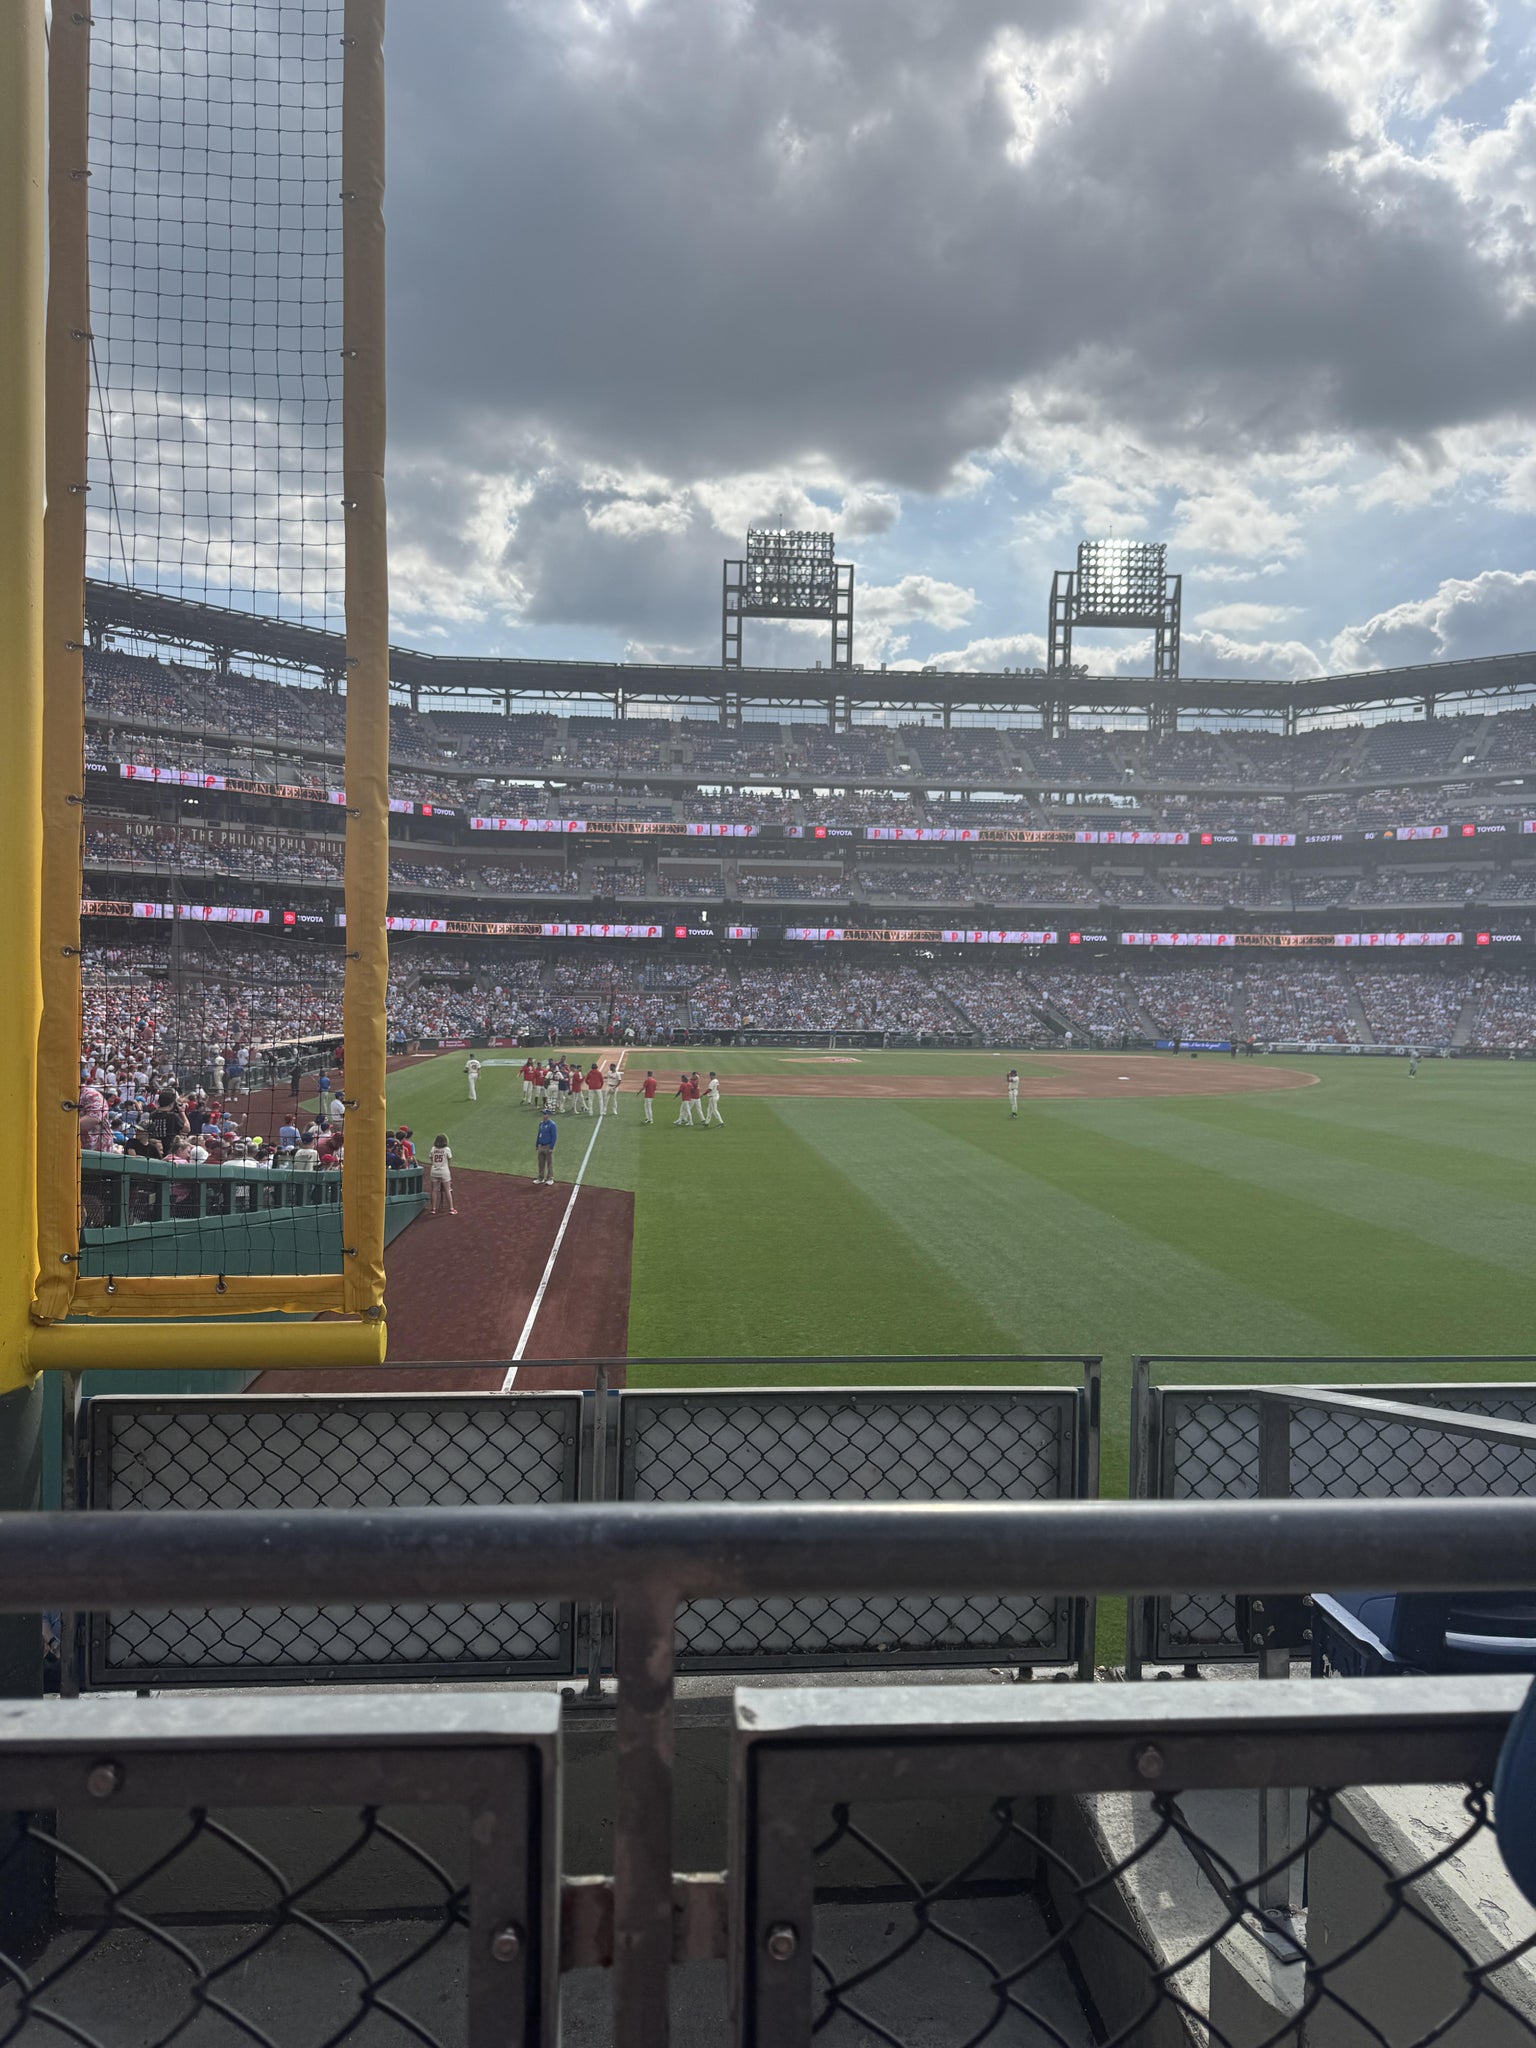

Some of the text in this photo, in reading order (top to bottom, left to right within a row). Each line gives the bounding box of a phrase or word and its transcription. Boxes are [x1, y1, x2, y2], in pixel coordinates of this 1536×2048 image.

[85, 763, 107, 772] YOTA
[227, 781, 271, 796] ALUMNI
[433, 807, 456, 816] TOYOTA
[588, 822, 629, 833] ALUMNI
[1477, 825, 1506, 833] TOYOTA
[191, 828, 213, 841] THE
[447, 923, 543, 935] ALUMNI WEEKEND
[845, 930, 942, 941] ALUMNI WEEKEND
[434, 1154, 443, 1163] 25
